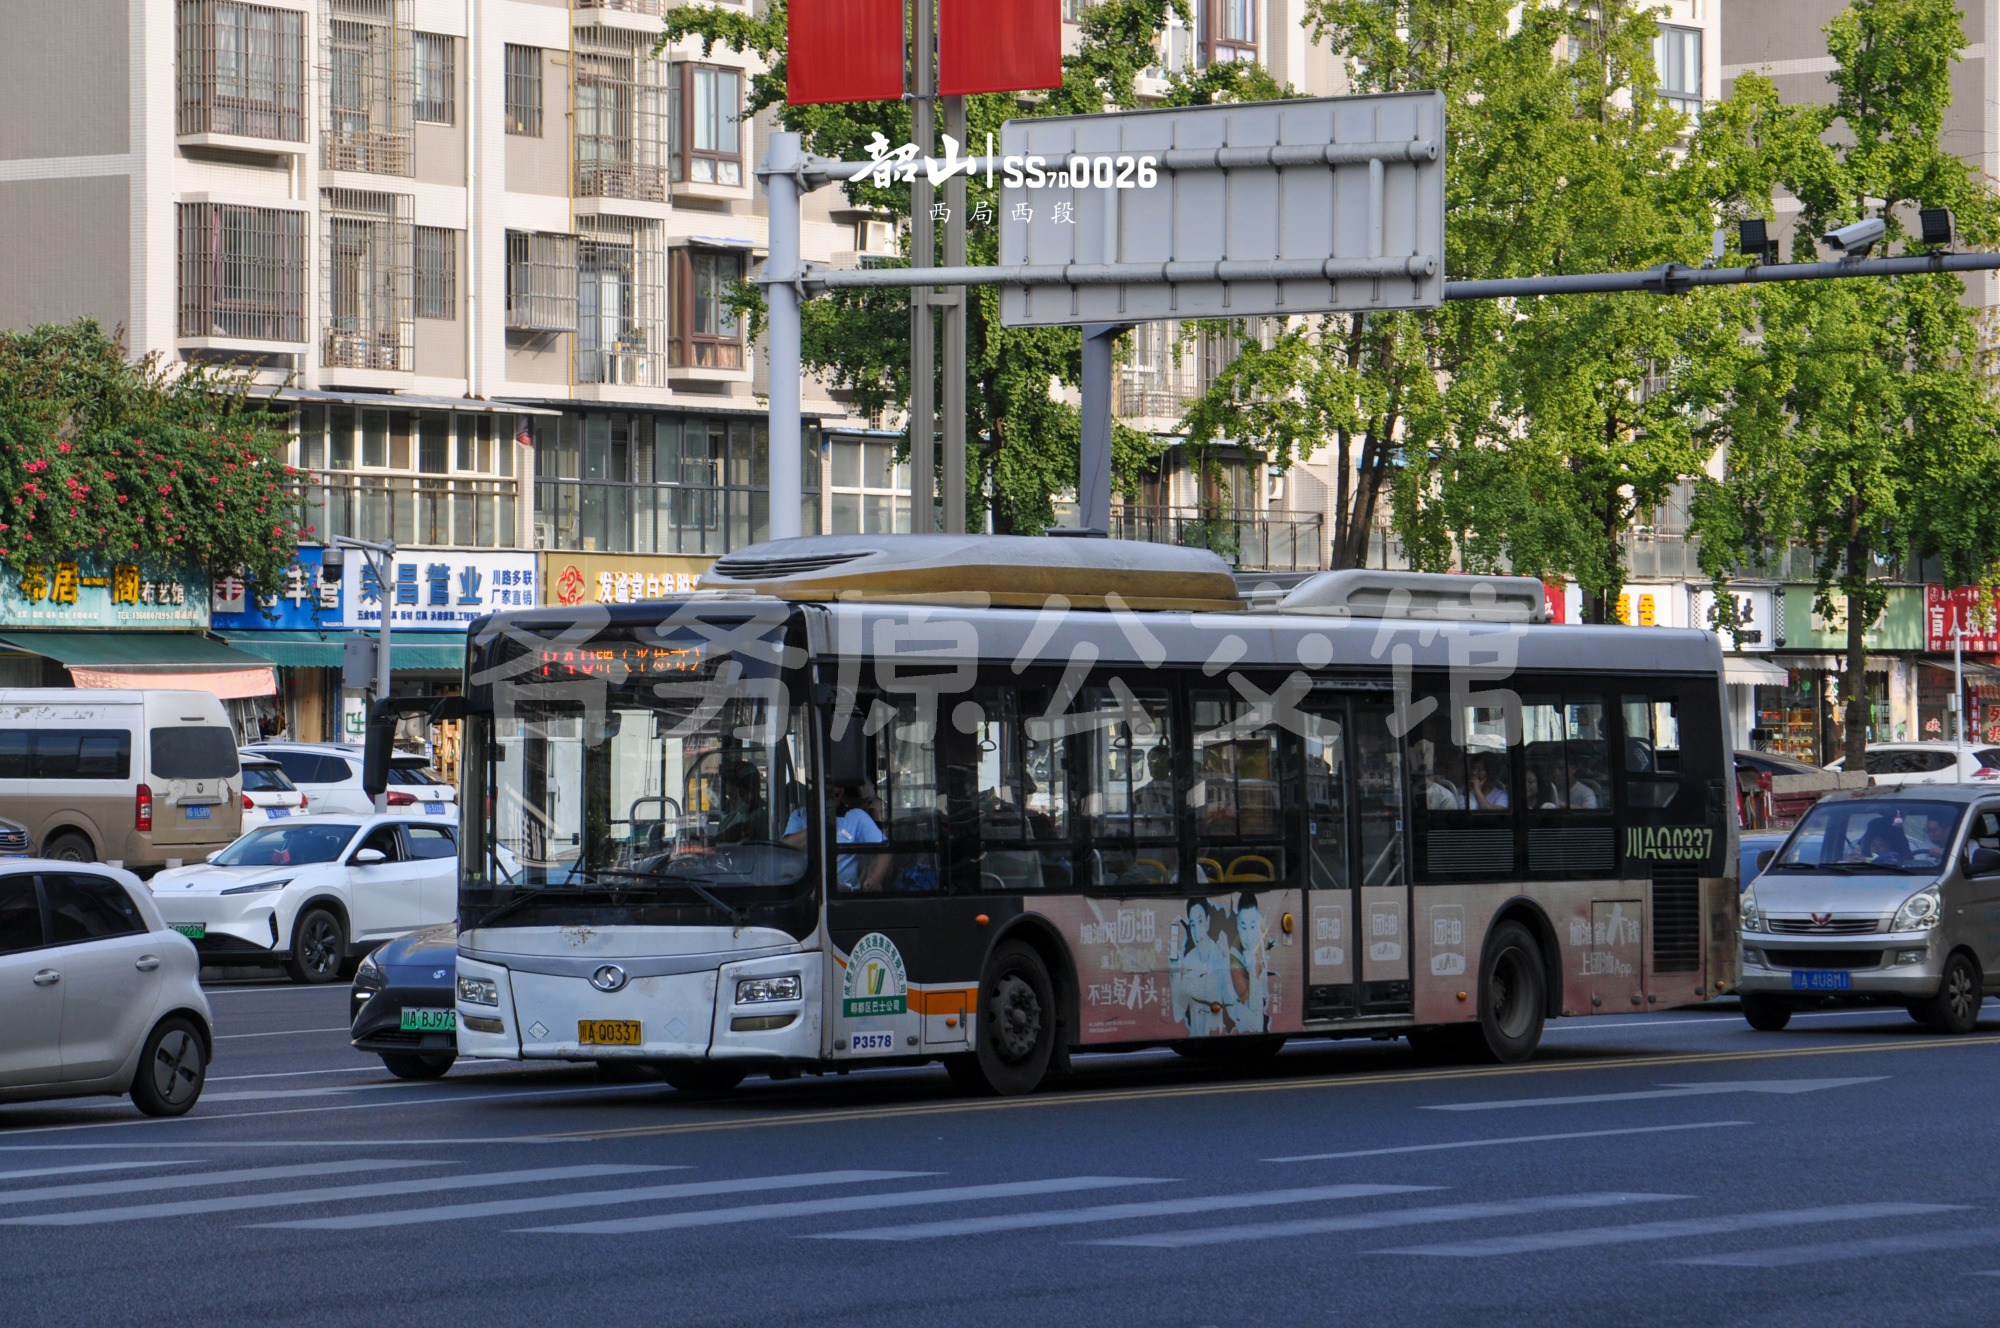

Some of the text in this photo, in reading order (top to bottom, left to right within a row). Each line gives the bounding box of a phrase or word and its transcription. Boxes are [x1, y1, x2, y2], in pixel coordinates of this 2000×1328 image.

[361, 563, 482, 606] 荣昌管业
[492, 569, 533, 586] 川路多联
[142, 582, 185, 604] 布艺馆
[491, 588, 533, 606] 厂家直销
[1930, 605, 1998, 638] 盲人按摩
[1626, 827, 1713, 860] 川AQ0337
[1087, 974, 1158, 1010] 不当冤大头
[853, 1035, 892, 1049] P3578
